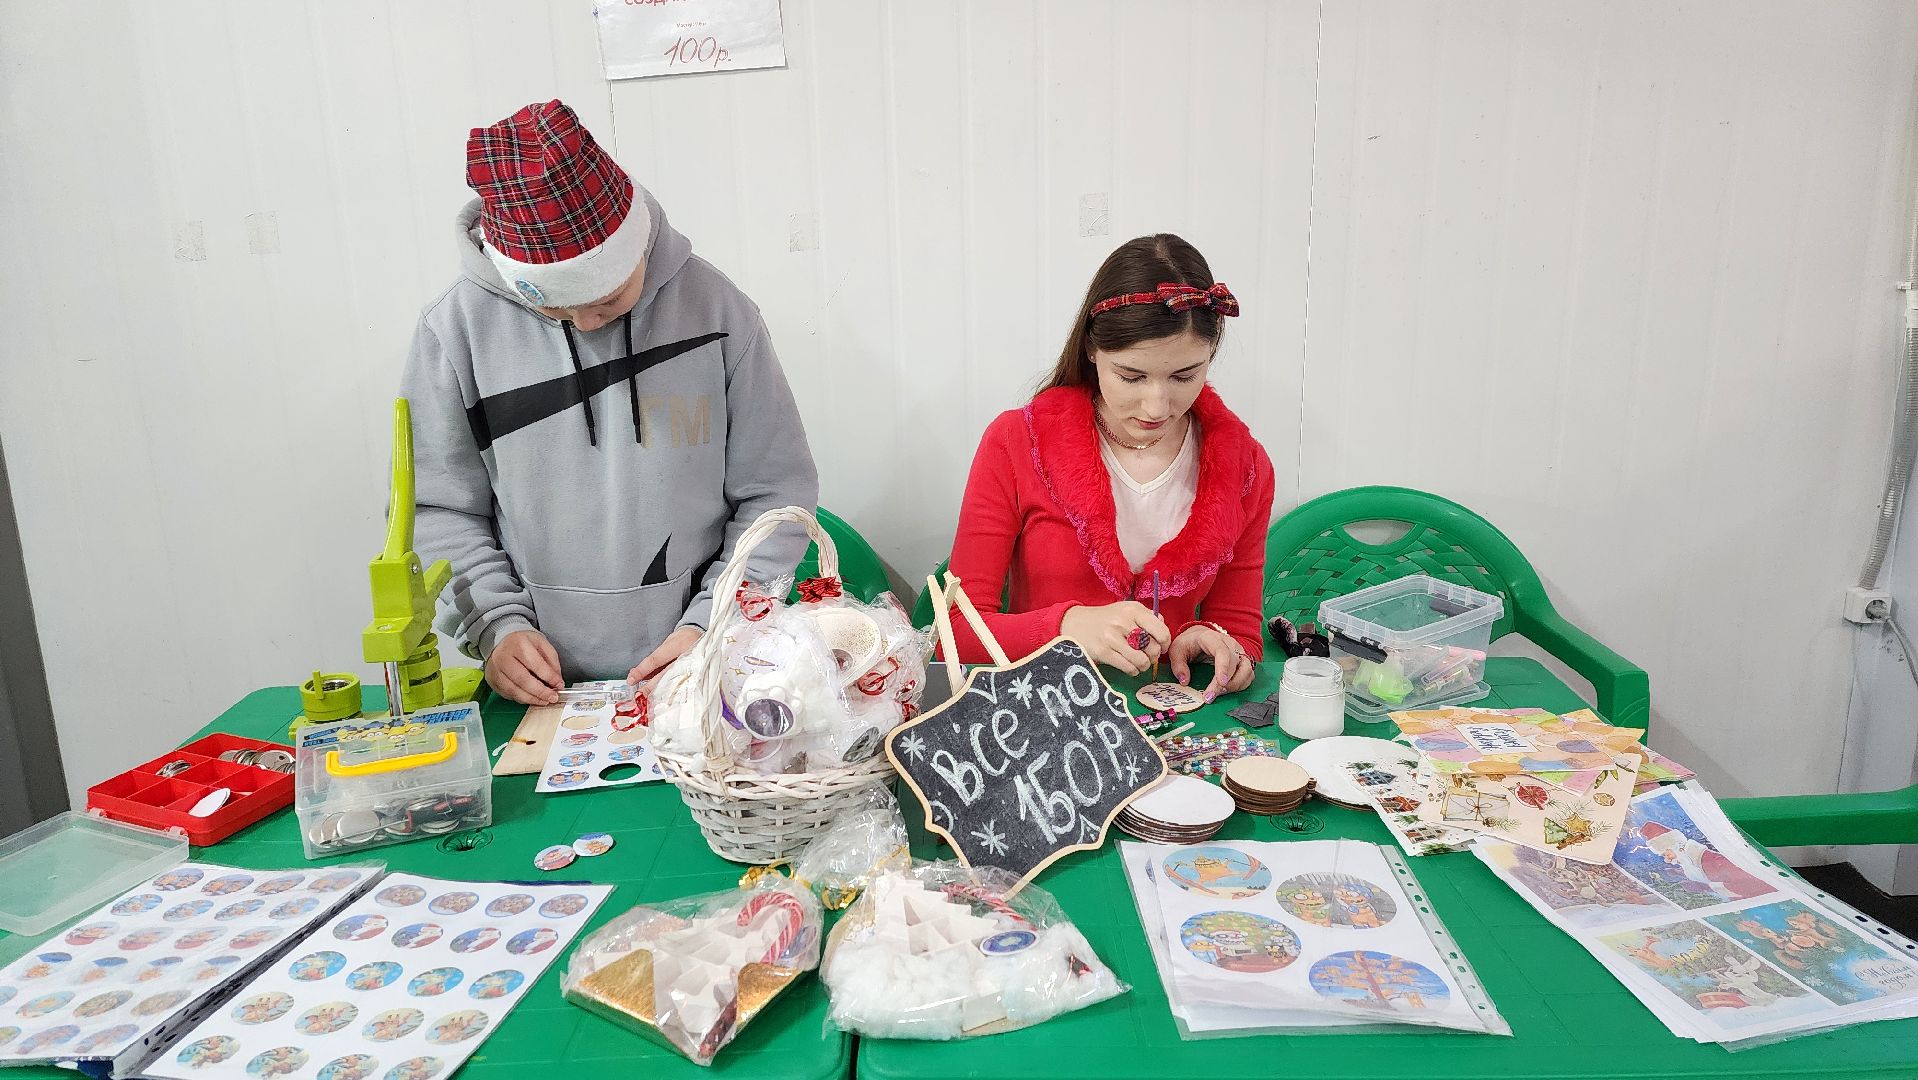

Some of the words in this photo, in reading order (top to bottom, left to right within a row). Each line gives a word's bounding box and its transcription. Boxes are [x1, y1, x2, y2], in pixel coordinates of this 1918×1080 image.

[664, 36, 732, 68] 100р.
[930, 708, 1030, 806] Все
[1037, 664, 1100, 727] по
